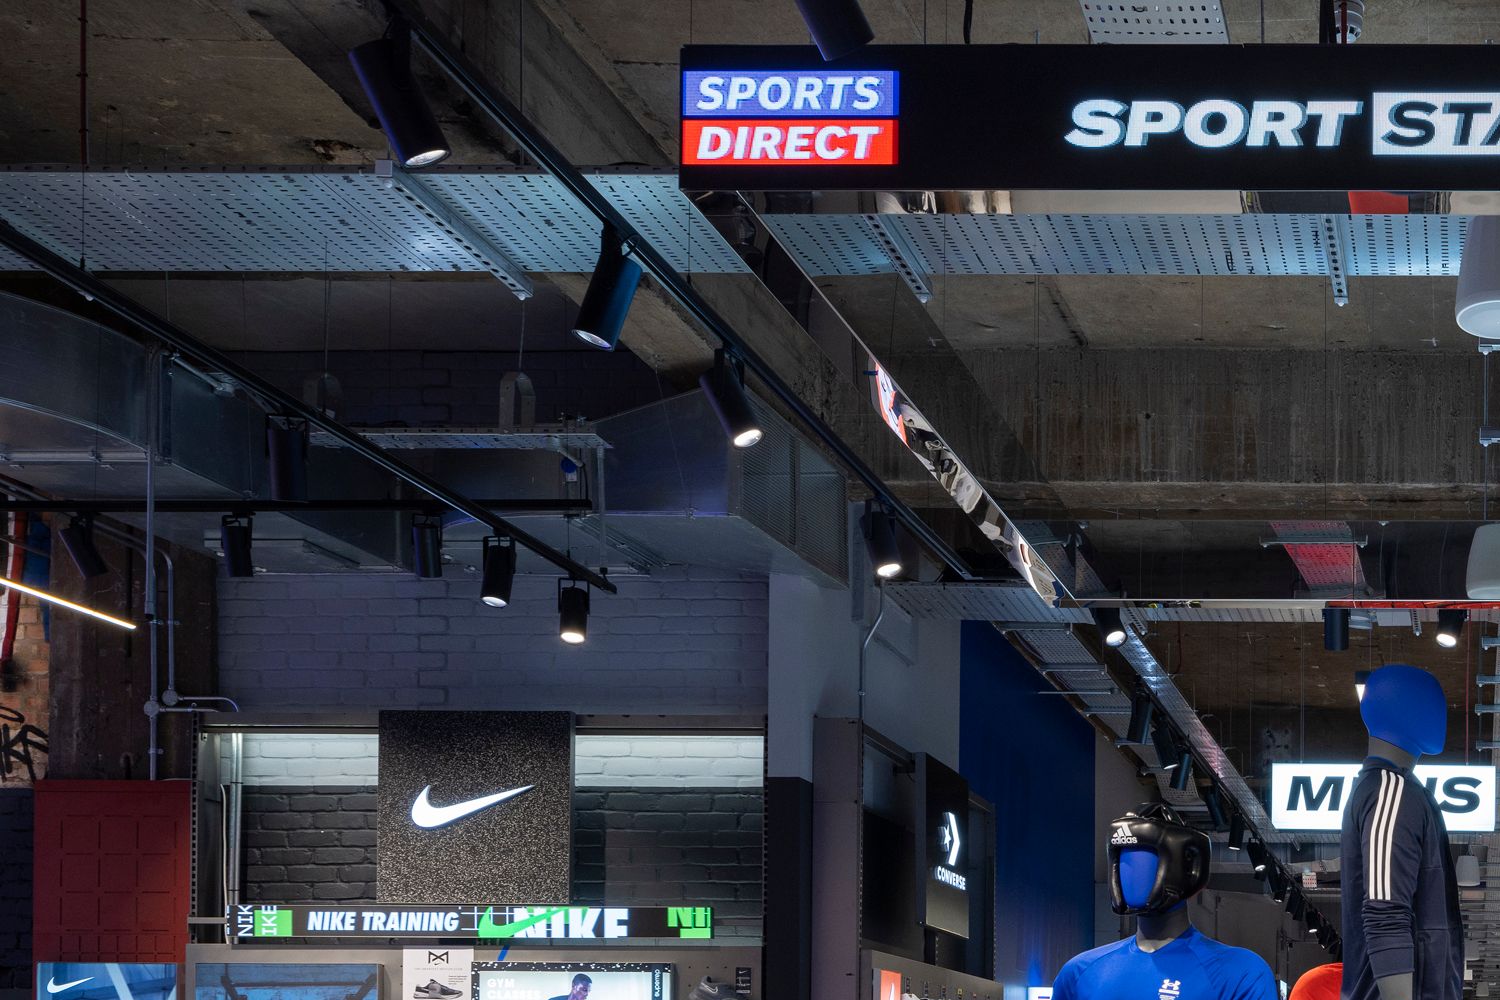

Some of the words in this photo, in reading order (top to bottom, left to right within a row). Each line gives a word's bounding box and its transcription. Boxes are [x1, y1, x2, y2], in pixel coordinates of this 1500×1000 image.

[695, 76, 881, 110] SPORTS
[1064, 99, 1361, 147] SPORT
[696, 126, 882, 159] DIRECT
[1285, 776, 1482, 814] MS
[1111, 835, 1138, 845] adidas
[937, 865, 966, 891] CONVERSE
[307, 911, 356, 931] NIKE
[362, 911, 459, 932] TRAINING
[487, 978, 515, 988] GYM
